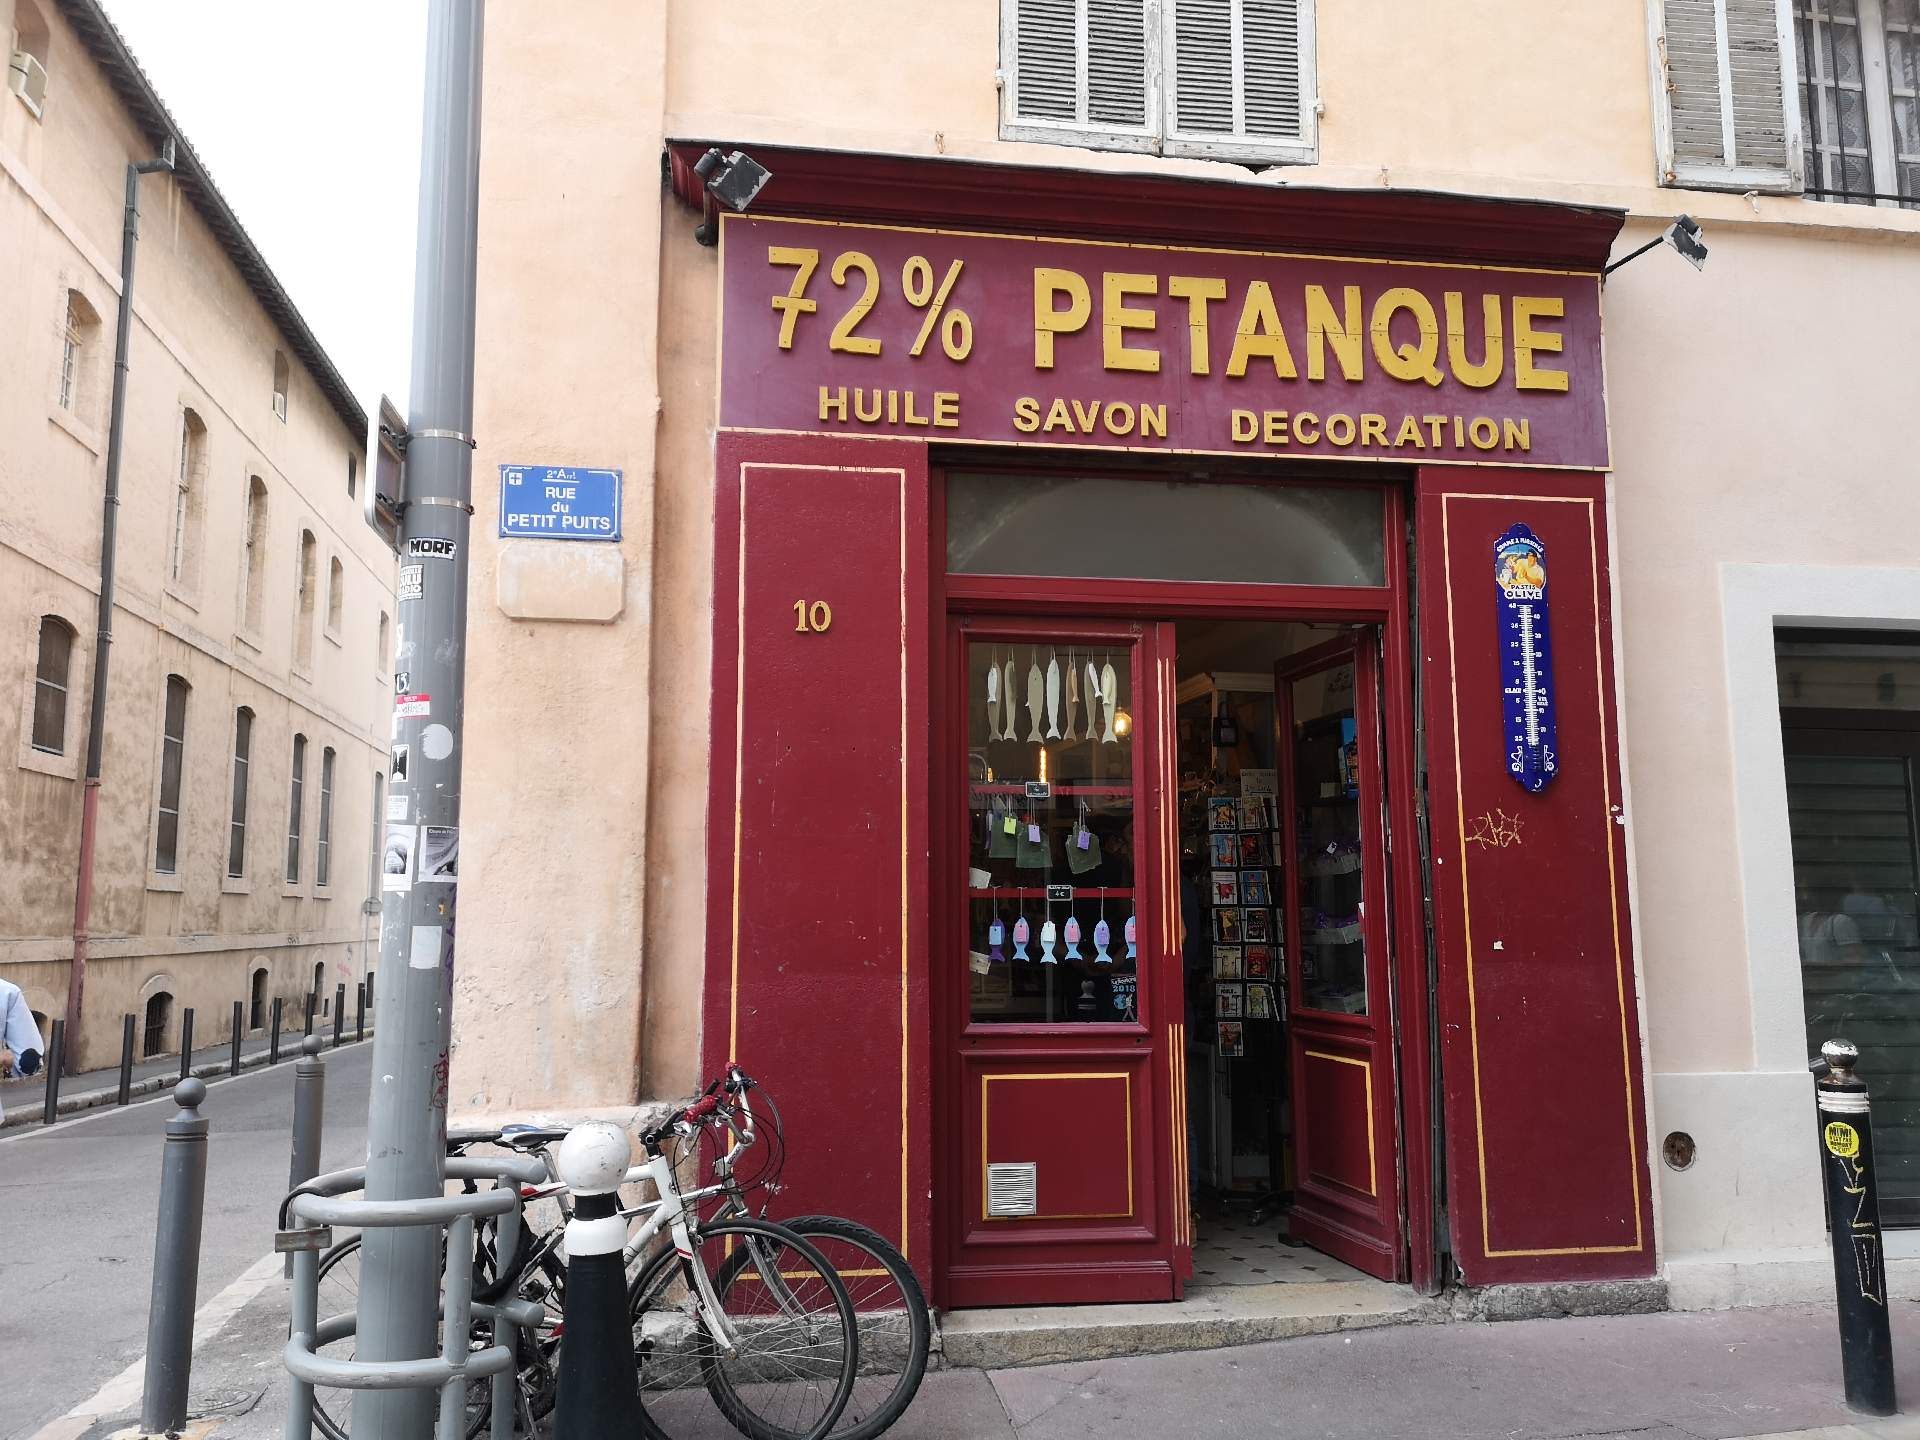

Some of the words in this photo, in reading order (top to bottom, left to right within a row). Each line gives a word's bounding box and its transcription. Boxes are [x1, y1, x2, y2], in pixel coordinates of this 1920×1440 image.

[768, 246, 973, 361] 72%
[1034, 267, 1569, 391] PETANQUE
[818, 386, 960, 428] HUILE
[1013, 397, 1168, 438] SAVON
[1231, 409, 1531, 451] DECORATION
[545, 486, 576, 499] RUE
[551, 501, 569, 513] du
[507, 514, 556, 528] PETIT
[562, 515, 610, 530] PUITS
[410, 539, 455, 555] MORF
[1506, 590, 1541, 599] OLIVE
[793, 599, 832, 632] 10
